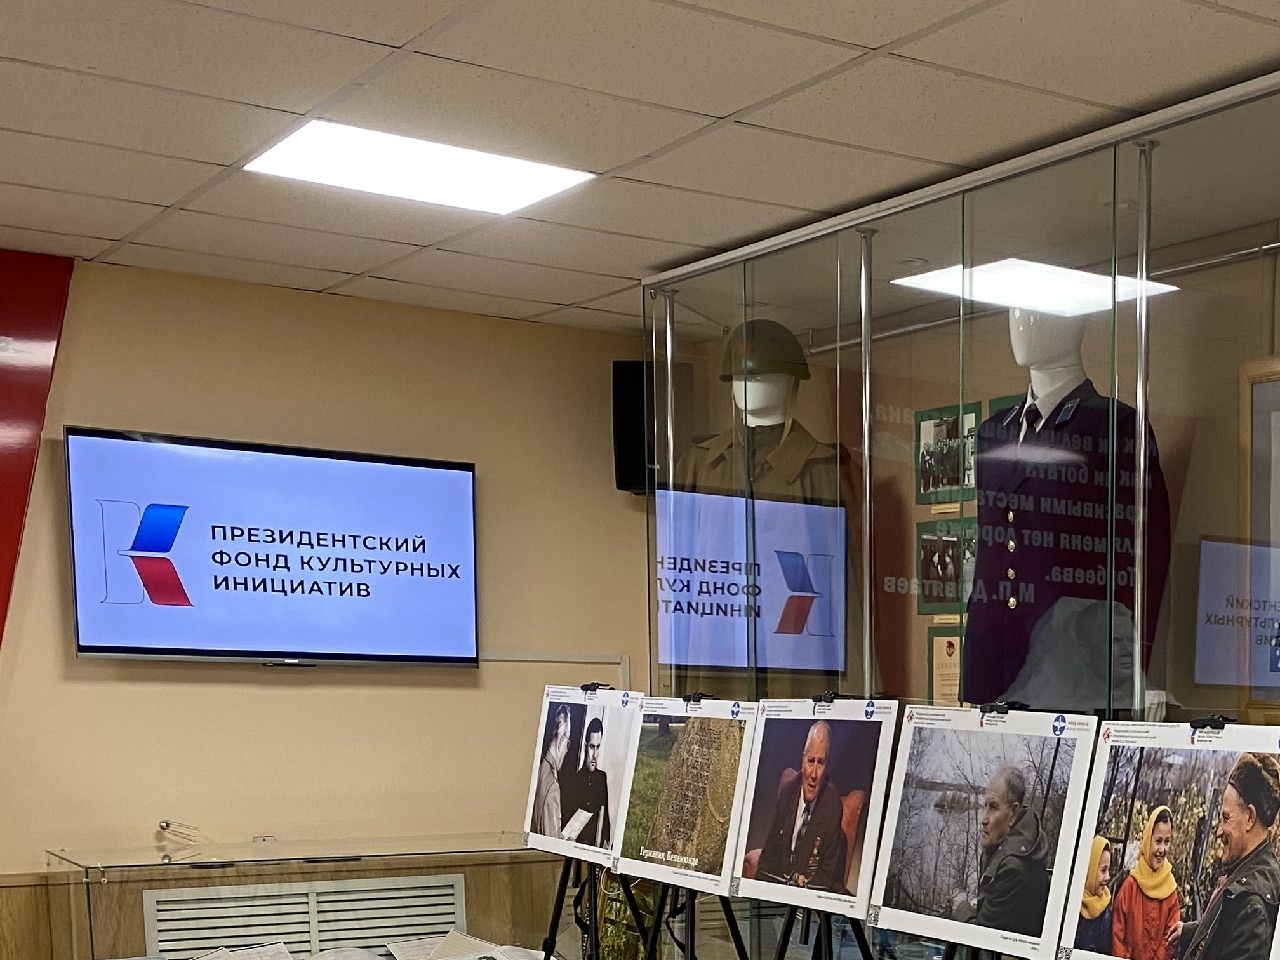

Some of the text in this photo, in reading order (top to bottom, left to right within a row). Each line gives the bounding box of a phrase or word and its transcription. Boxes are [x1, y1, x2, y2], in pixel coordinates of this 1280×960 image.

[210, 525, 427, 554] ПРЕЗИДЕНТСКИЙ
[211, 549, 462, 579] ФОНД КУЛЬТУРНЫХ
[213, 574, 371, 598] ИНИЦИАТИВ
